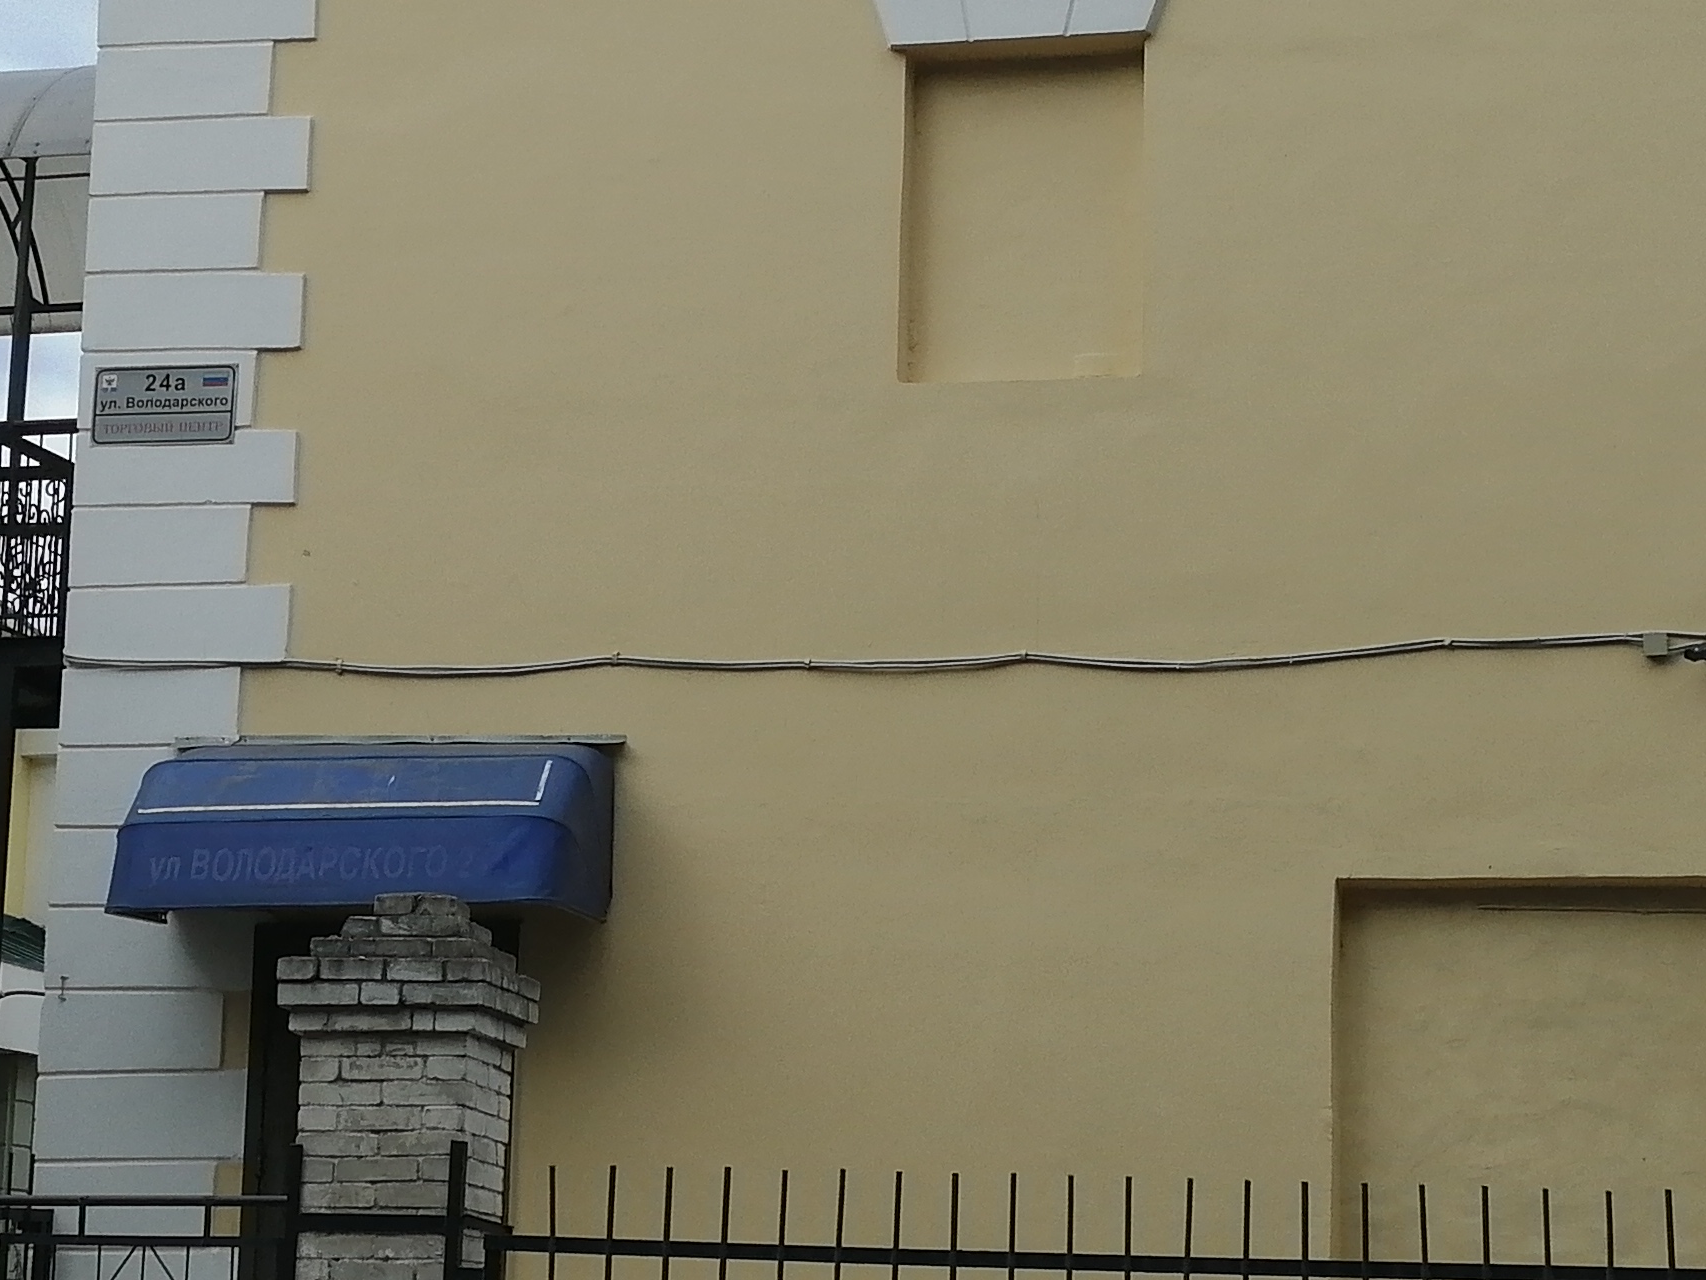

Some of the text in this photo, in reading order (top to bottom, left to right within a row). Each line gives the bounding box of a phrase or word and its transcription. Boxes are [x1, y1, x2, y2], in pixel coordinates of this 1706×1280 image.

[145, 373, 186, 391] 24а
[100, 396, 228, 412] ул. Володарского
[103, 421, 224, 434] ТОРГОВЫЙ ЦЕНТР
[189, 845, 448, 884] ВОЛОДАРСКОГО
